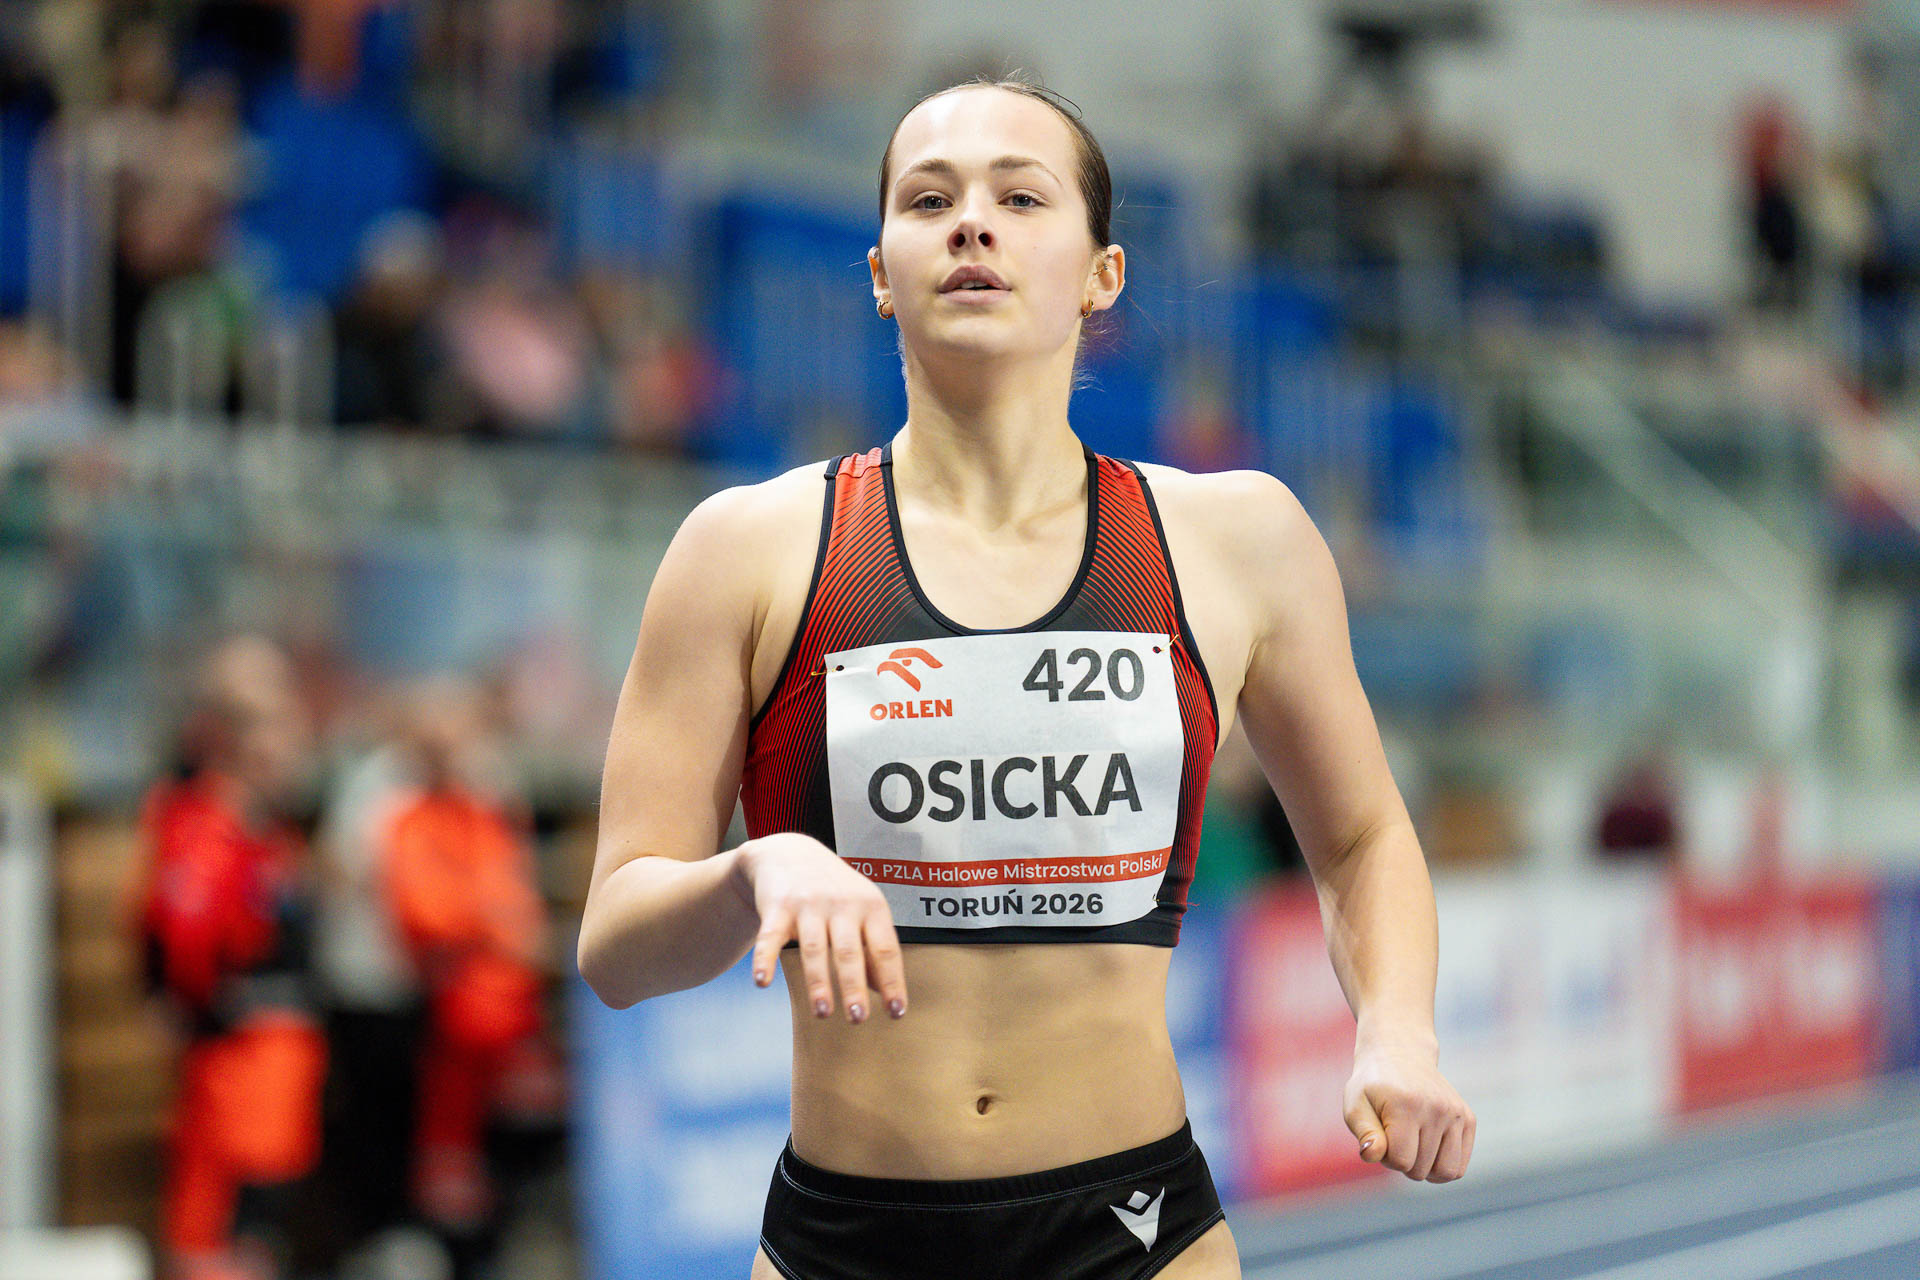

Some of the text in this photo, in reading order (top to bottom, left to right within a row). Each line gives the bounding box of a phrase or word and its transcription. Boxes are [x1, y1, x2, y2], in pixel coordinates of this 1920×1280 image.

[1022, 647, 1145, 703] 420
[869, 698, 953, 721] ORLEN
[867, 752, 1143, 824] OSICKA
[851, 853, 1163, 882] 70. PZLA Halowe Mistrzostwa Polski
[919, 888, 1104, 917] TORUŃ 2026
